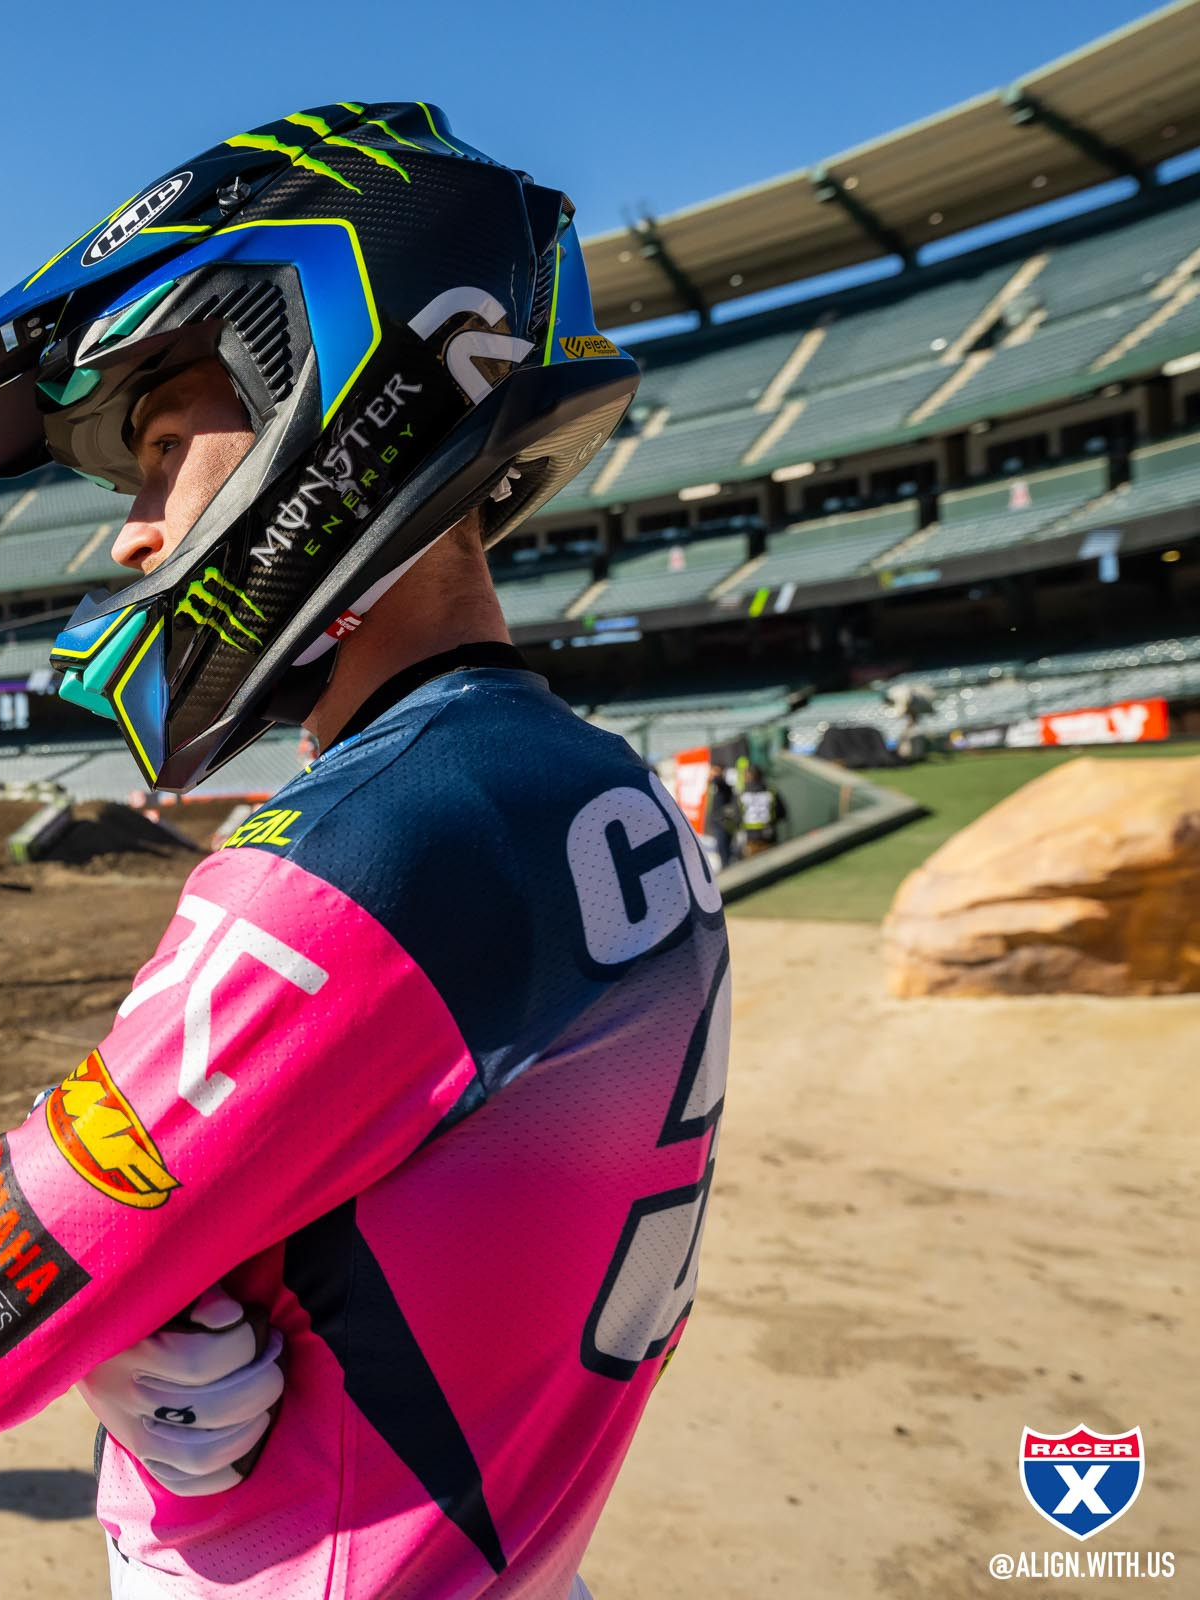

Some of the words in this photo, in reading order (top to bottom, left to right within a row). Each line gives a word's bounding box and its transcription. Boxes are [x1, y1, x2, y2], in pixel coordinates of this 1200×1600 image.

[97, 181, 177, 256] HJC
[584, 337, 612, 353] eject
[250, 373, 423, 567] MONSTER
[304, 423, 414, 557] ENERGY
